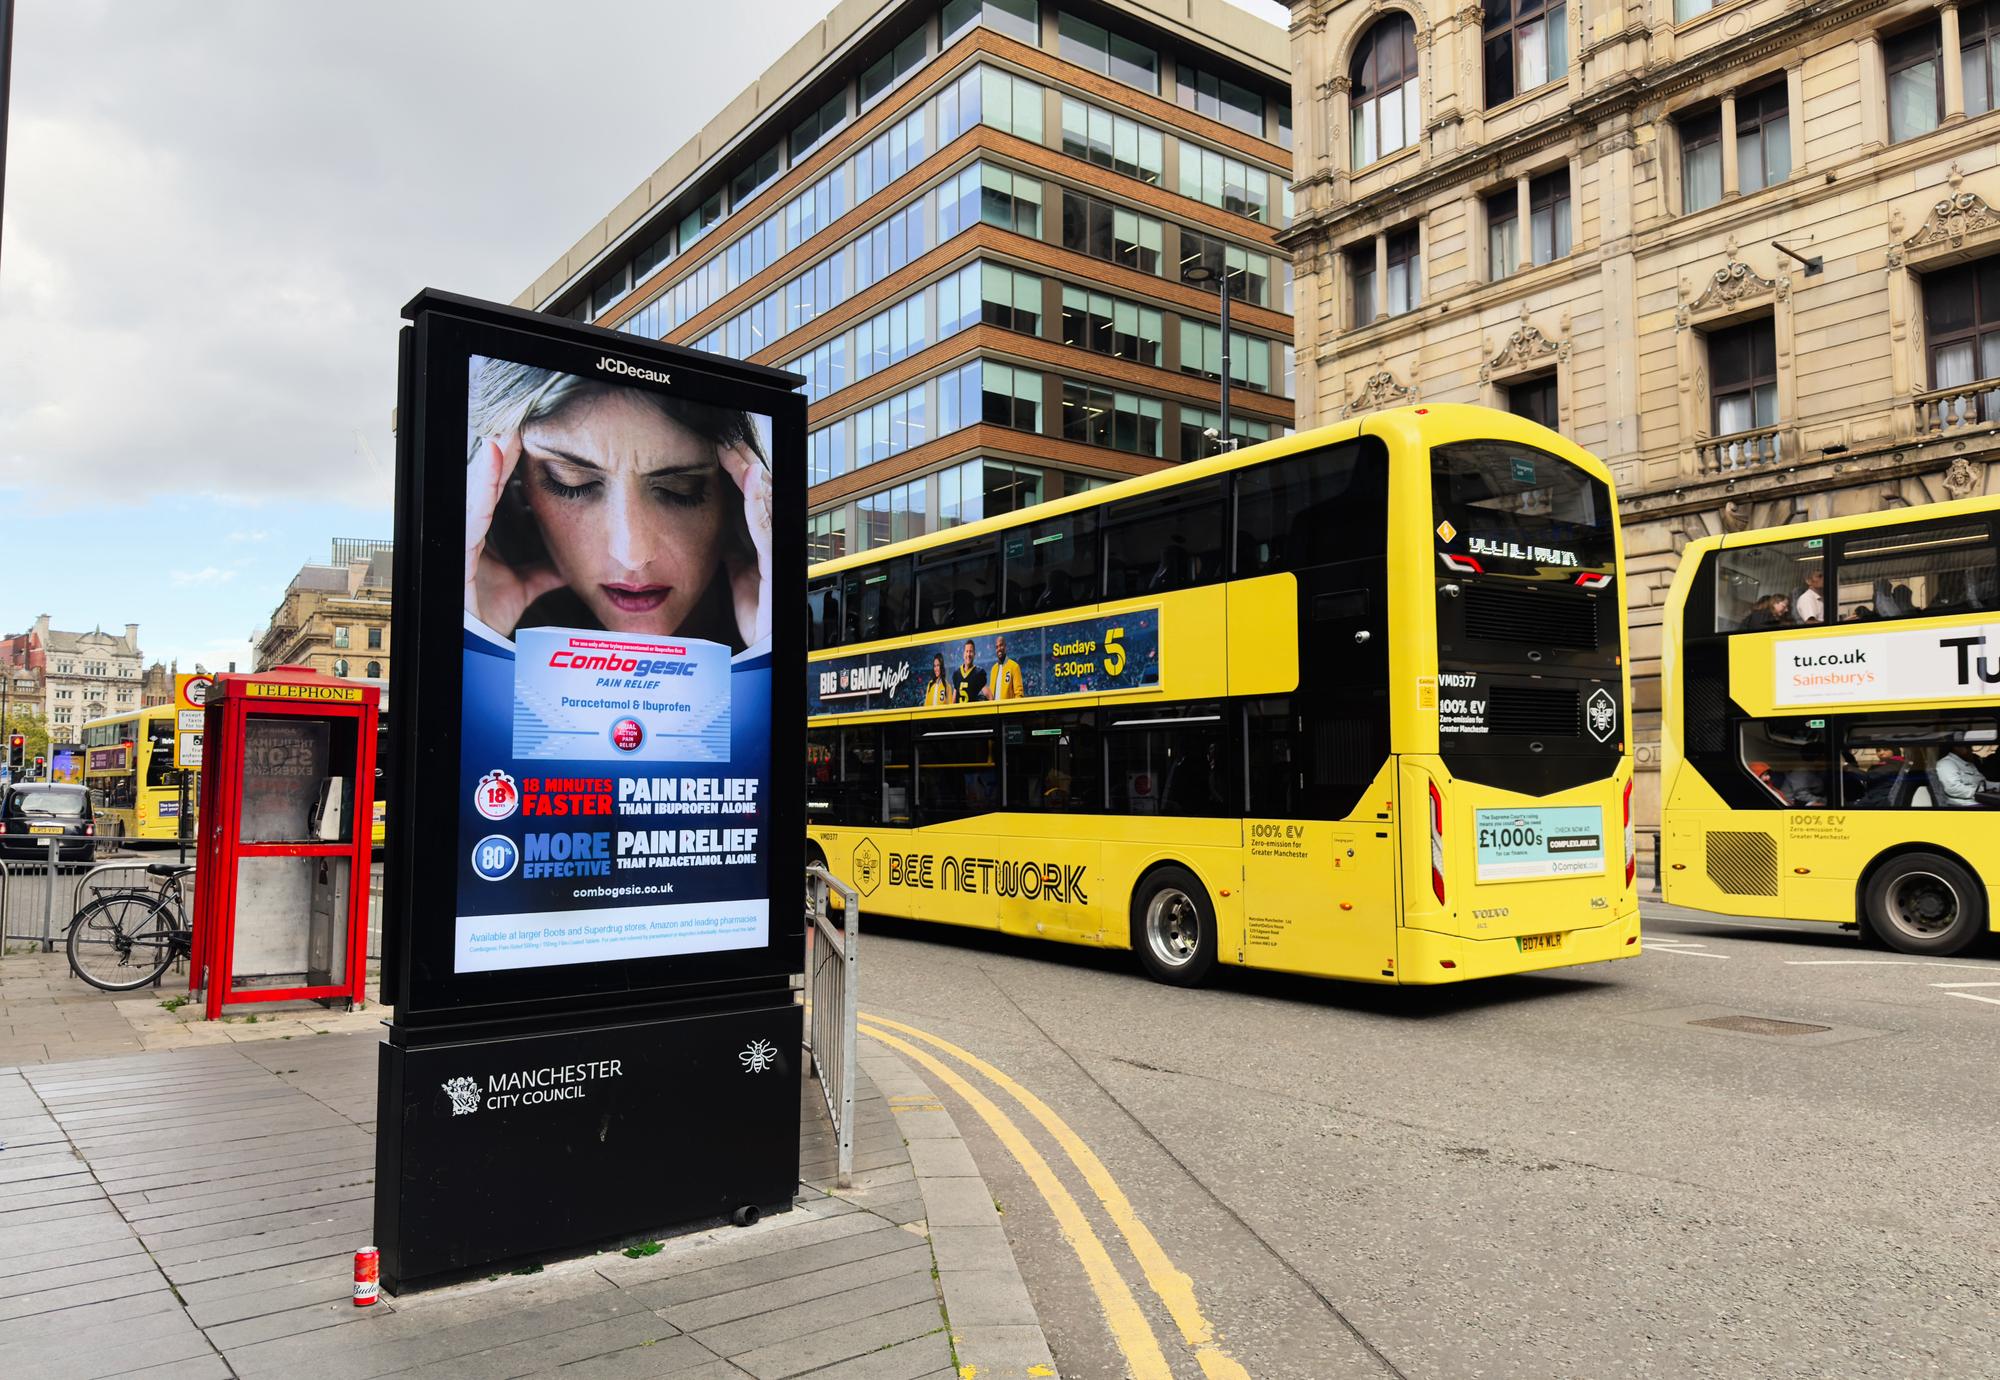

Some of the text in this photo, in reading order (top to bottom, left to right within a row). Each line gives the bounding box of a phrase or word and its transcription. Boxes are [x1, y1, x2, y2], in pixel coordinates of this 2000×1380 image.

[596, 355, 671, 385] JCDecaux
[1053, 639, 1096, 657] Sundays
[1104, 627, 1126, 677] 5
[548, 651, 698, 677] Combogesic
[1794, 648, 1866, 668] tu.co.uk
[1939, 636, 2000, 686] Tu
[1055, 661, 1095, 678] 5.30pm
[596, 678, 661, 690] PAIN RELIEF
[820, 661, 910, 699] BIG GAME Night
[1438, 673, 1476, 688] VMD377
[1793, 671, 1875, 688] Sainsbury's
[255, 684, 354, 700] TELEPHONE
[959, 682, 969, 704] 5
[561, 696, 691, 714] Paracetamol & Ibuprofen
[1440, 699, 1467, 714] 100%
[1470, 700, 1486, 714] EV
[1439, 714, 1484, 724] Zero-emission for
[1439, 724, 1489, 734] Greater Manchester
[522, 778, 612, 793] 18 MINUTES
[619, 777, 759, 802] PAIN RELIEF
[487, 787, 507, 803] 18
[522, 794, 612, 817] FASTER
[619, 802, 757, 815] THAN IBUPROFEN ALONE
[1790, 815, 1846, 826] 100% EV
[1251, 824, 1305, 839] 100% EV
[524, 832, 610, 862] MORE
[617, 828, 758, 856] PAIN RELIEF
[1251, 839, 1302, 848] Zero-emission for
[617, 853, 757, 869] THAN PARACETAMOL ALONE
[1251, 848, 1308, 858] Greater Manchester
[523, 861, 611, 879] EFFECTIVE
[889, 852, 1088, 905] BEE NETWORK
[573, 882, 674, 898] combogesic.co.uk
[1472, 907, 1509, 919] VOLVO
[469, 931, 508, 943] Available
[509, 930, 517, 940] at
[518, 930, 542, 941] larger
[543, 927, 565, 938] Boots
[567, 926, 583, 936] and
[584, 924, 623, 936] Superdrug
[650, 920, 679, 930] Amazon
[680, 918, 693, 928] and
[695, 916, 719, 928] leading
[720, 915, 757, 927] pharmacies
[1522, 937, 1544, 951] BD74
[488, 1060, 623, 1093] MANCHESTER
[487, 1086, 586, 1110] CITY COUNCIL
